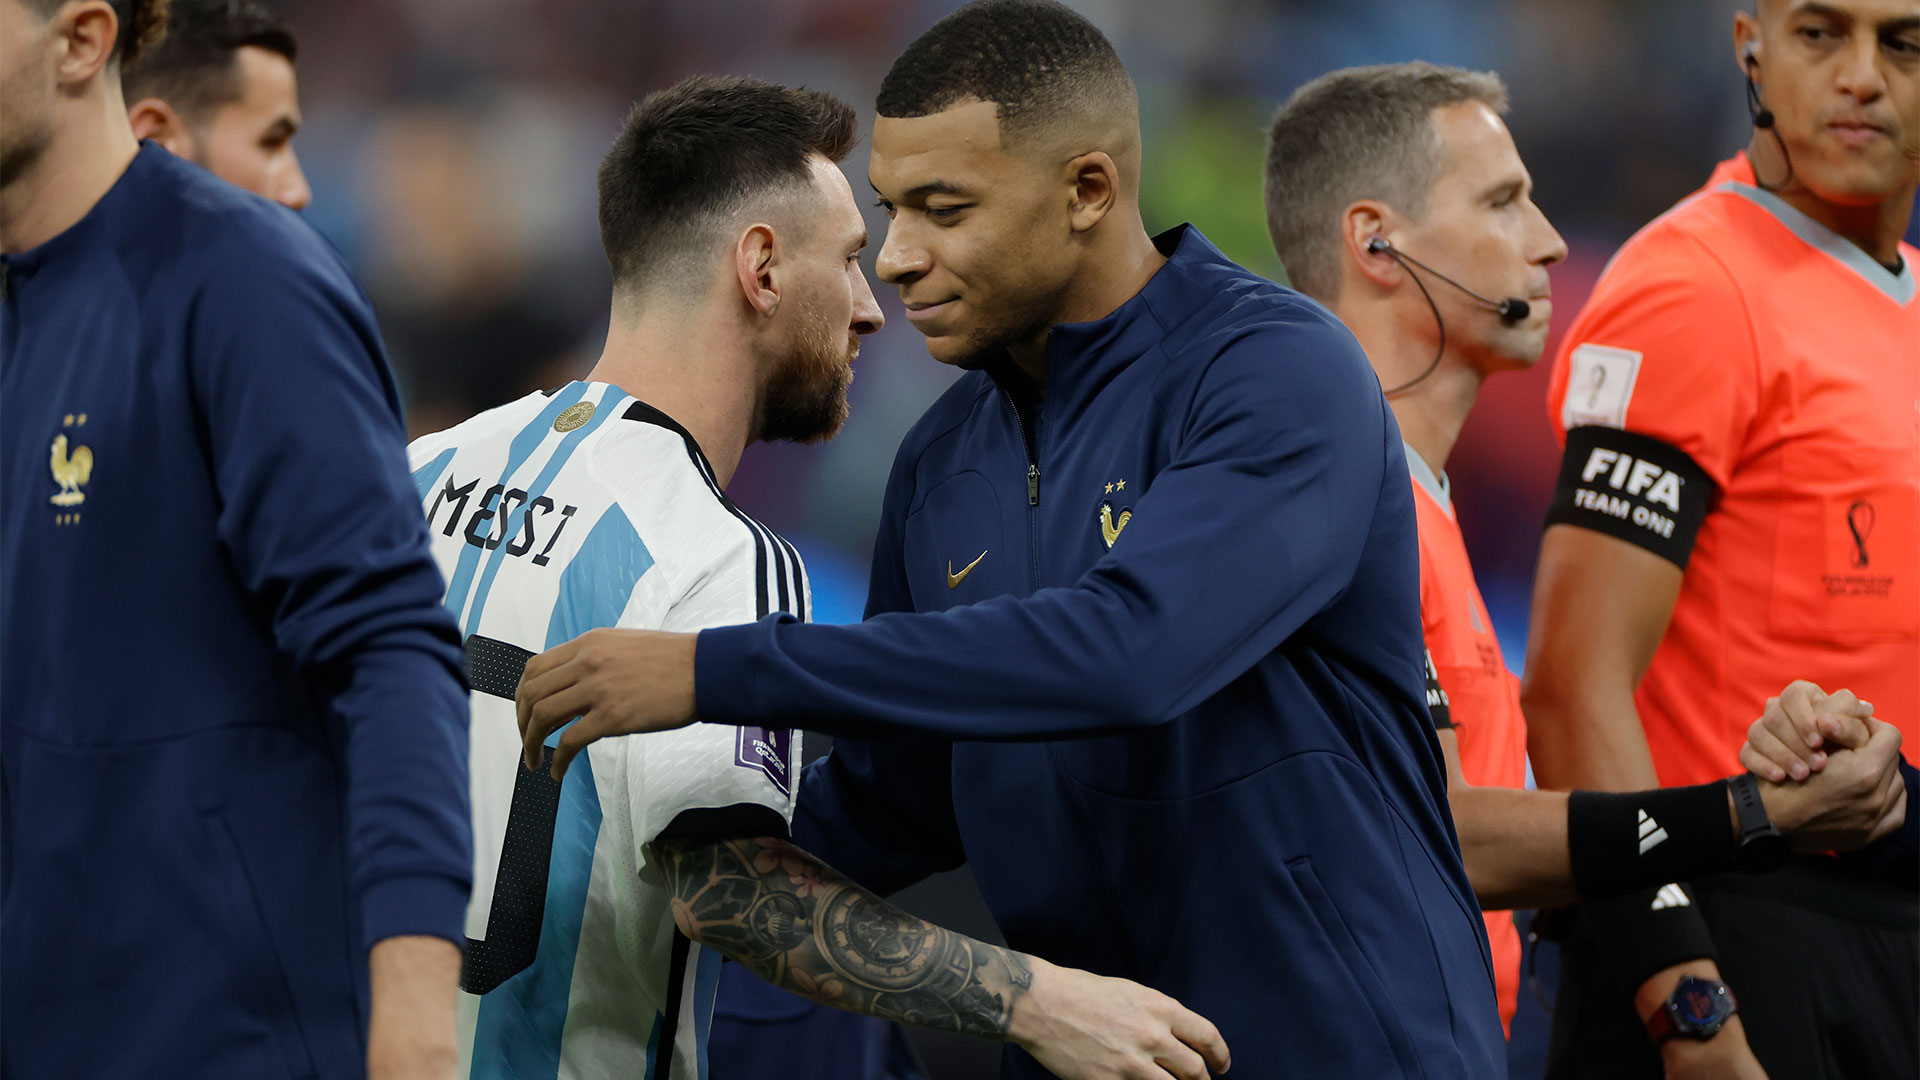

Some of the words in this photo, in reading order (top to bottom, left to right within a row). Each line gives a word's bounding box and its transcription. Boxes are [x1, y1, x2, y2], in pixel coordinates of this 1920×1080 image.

[1582, 447, 1680, 512] FIFA
[427, 472, 578, 567] MESSI
[1575, 488, 1631, 519] TEAM
[1632, 506, 1676, 538] ONE
